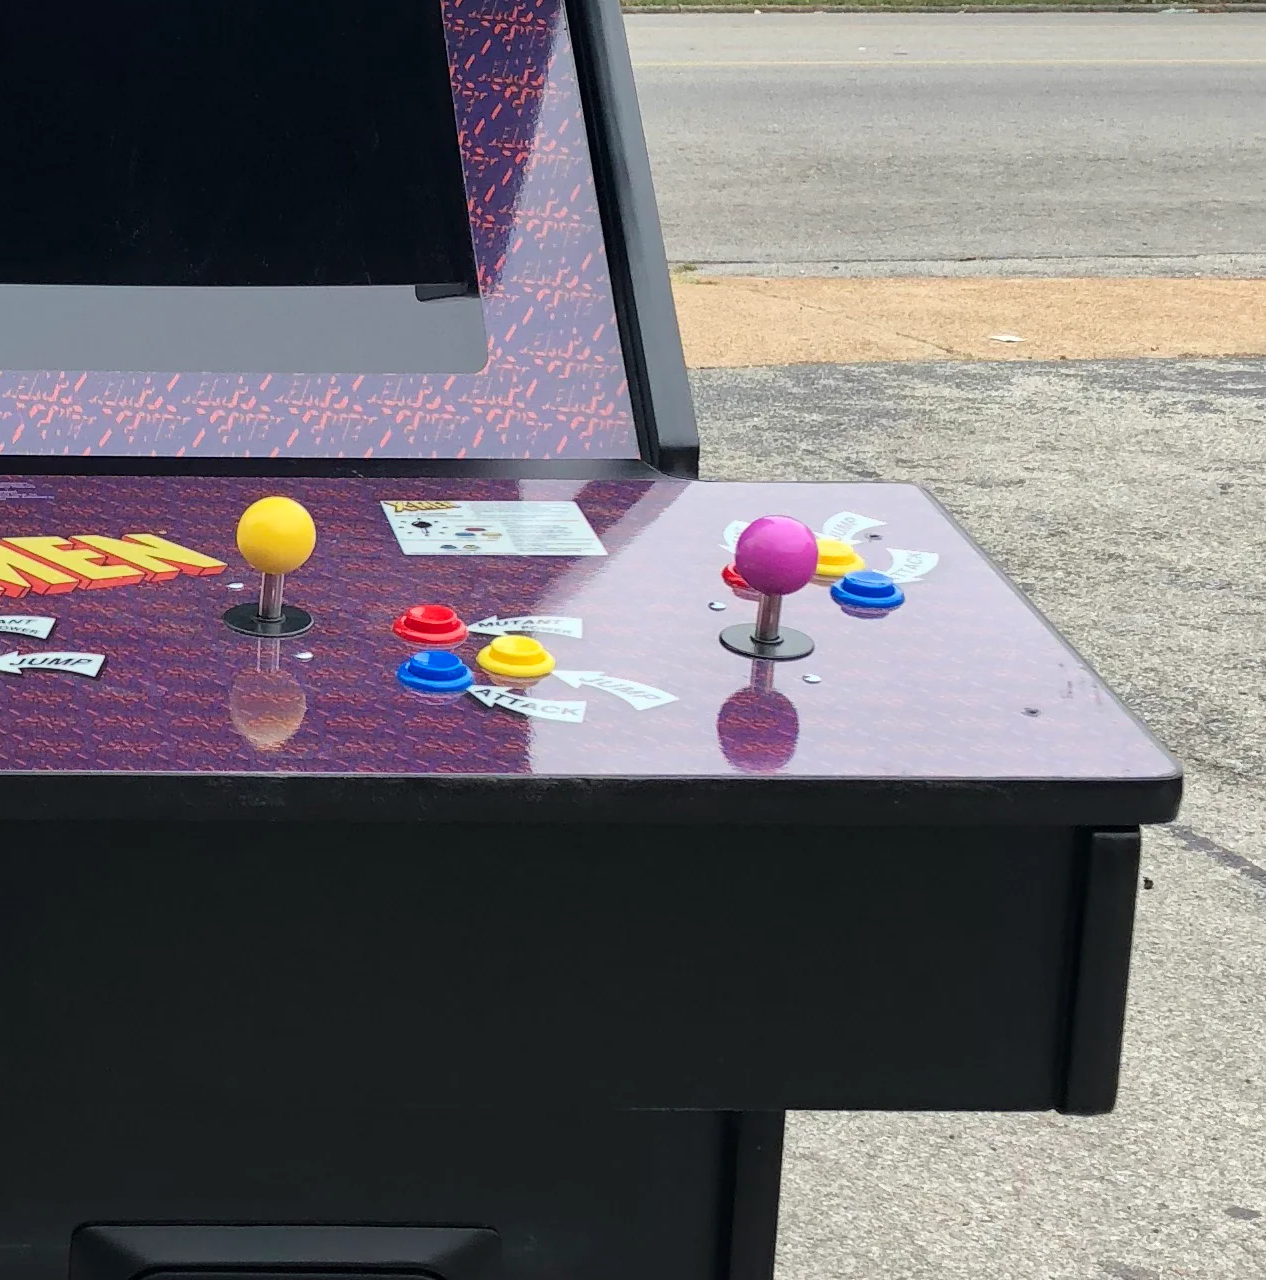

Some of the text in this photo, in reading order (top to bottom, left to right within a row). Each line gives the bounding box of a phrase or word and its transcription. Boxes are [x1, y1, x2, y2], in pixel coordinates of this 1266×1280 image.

[478, 619, 563, 628] MUTANT
[521, 625, 573, 634] POWER
[10, 657, 94, 668] JUMP
[579, 677, 662, 701] JUMP
[475, 688, 582, 716] ATTACK
